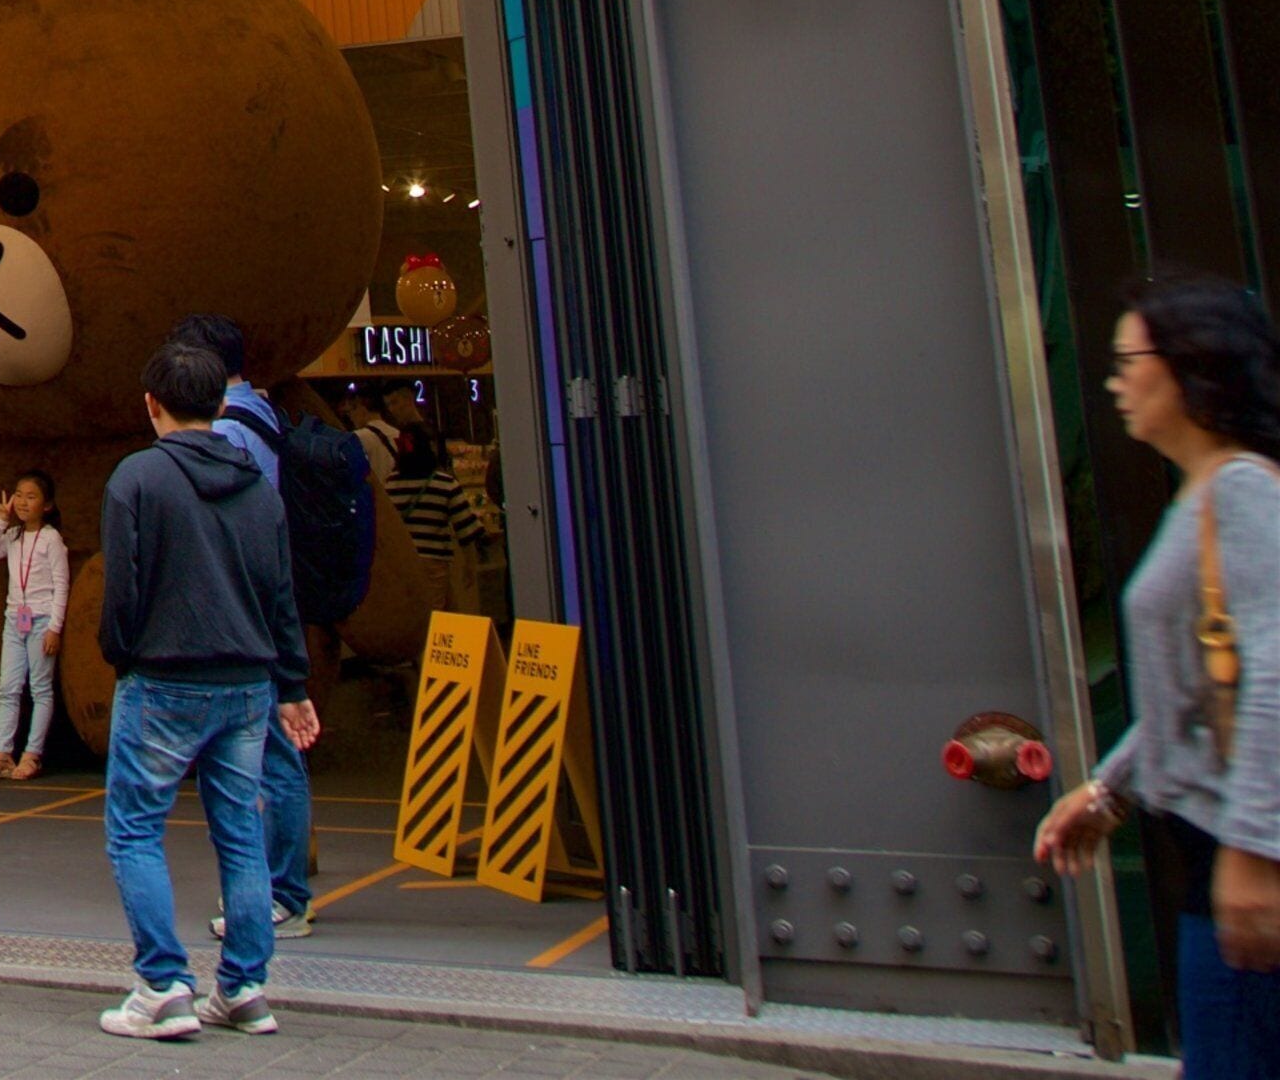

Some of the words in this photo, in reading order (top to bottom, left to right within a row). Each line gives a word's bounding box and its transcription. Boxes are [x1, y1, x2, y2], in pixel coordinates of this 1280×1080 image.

[414, 380, 425, 403] 2
[470, 379, 479, 402] 3
[431, 631, 454, 648] LINE
[516, 641, 541, 659] LINE
[429, 649, 470, 670] FRIENDS
[513, 659, 558, 682] FRIENDS
